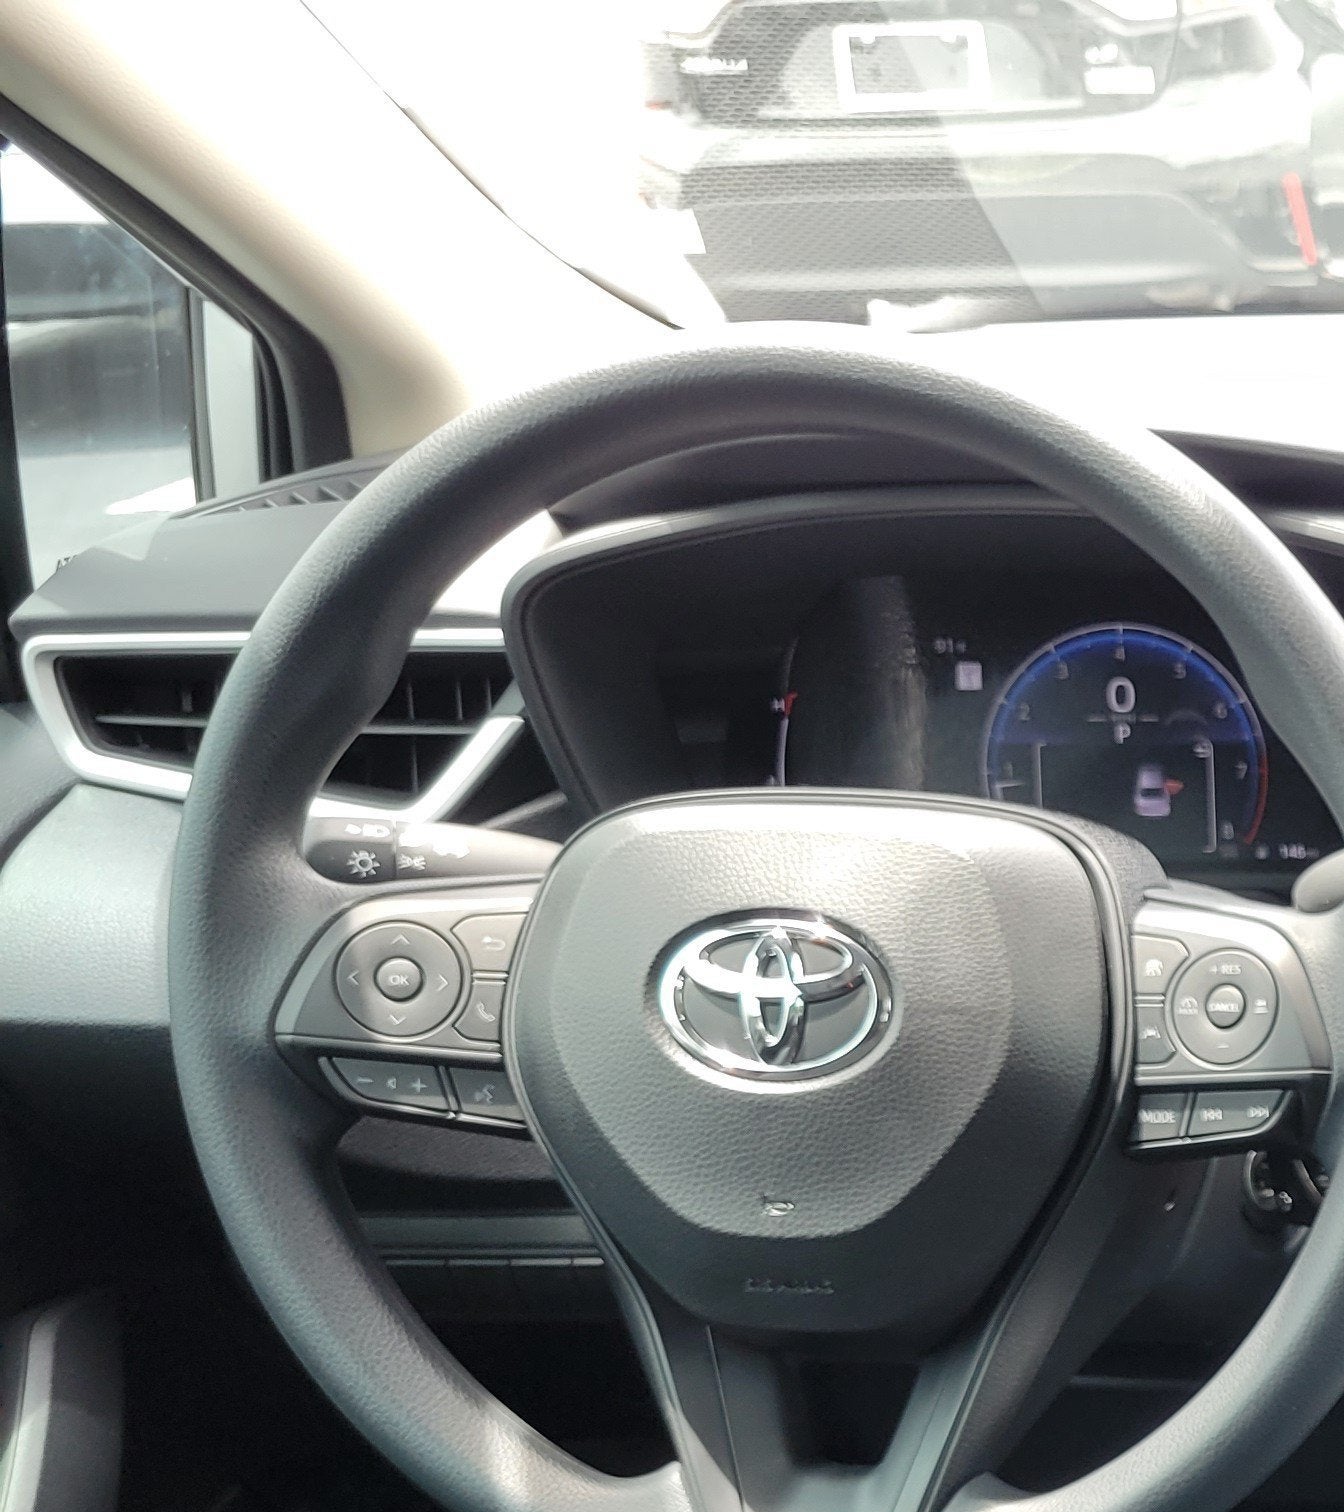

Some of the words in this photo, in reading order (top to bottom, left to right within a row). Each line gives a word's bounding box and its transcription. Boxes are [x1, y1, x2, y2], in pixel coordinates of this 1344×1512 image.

[1105, 675, 1136, 714] 0
[1221, 965, 1242, 975] RES
[389, 974, 410, 986] OK
[1208, 1002, 1240, 1013] CANCEL
[1139, 1109, 1177, 1124] MODE
